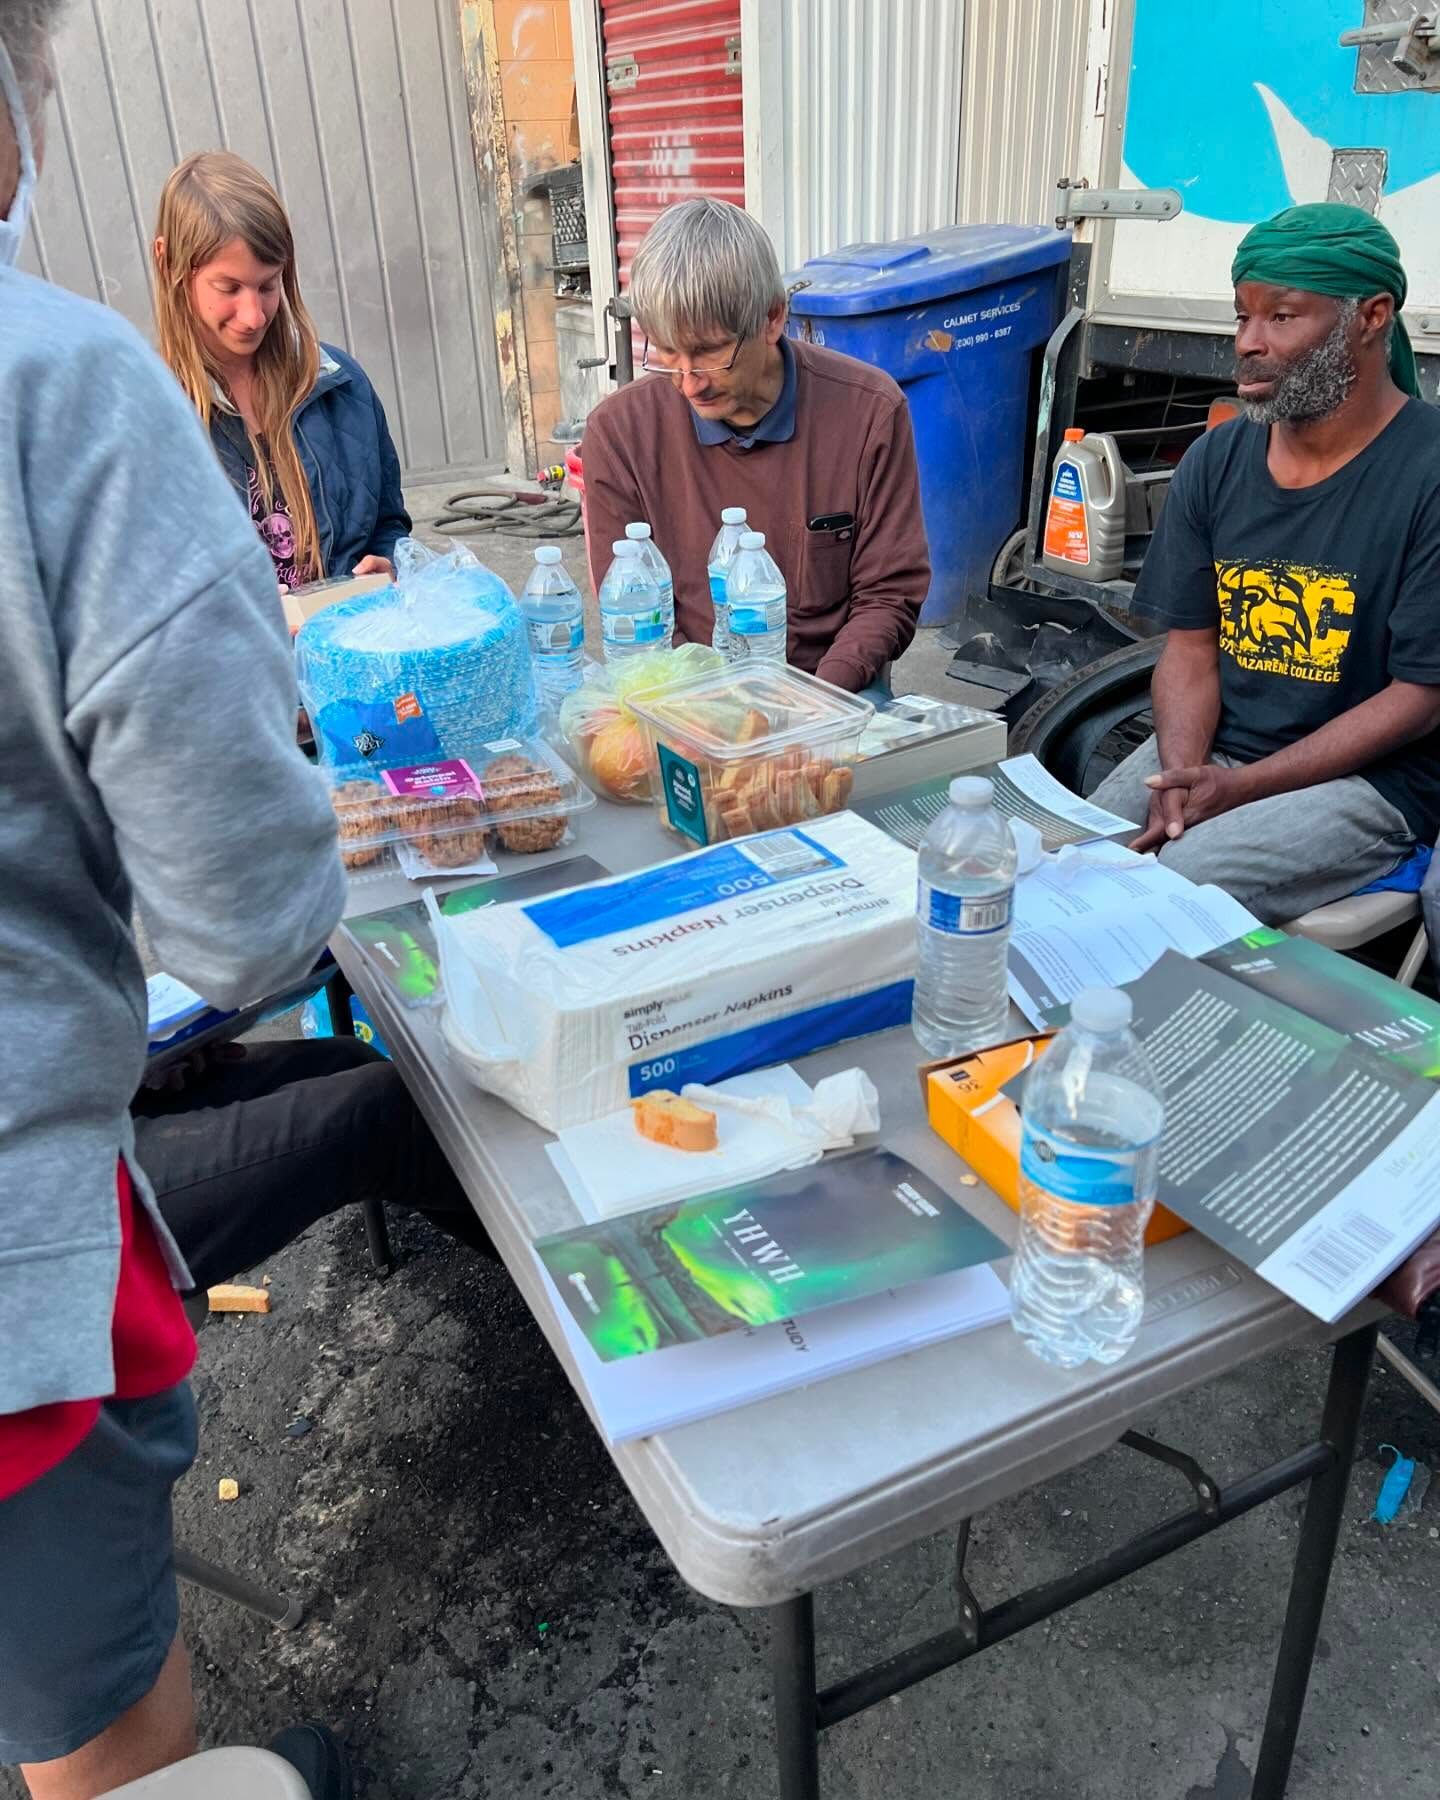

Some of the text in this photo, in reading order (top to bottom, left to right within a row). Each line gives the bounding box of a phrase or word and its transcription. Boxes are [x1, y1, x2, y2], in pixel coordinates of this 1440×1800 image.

[943, 302, 1021, 329] CALMET SERVICES
[1290, 664, 1341, 683] COLLEGE
[716, 871, 771, 897] 500
[734, 877, 865, 920] Dispenser
[612, 913, 729, 957] Napkins
[623, 999, 664, 1019] simply
[723, 983, 793, 1017] Napkins
[1353, 1015, 1434, 1048] HWH
[640, 1057, 676, 1081] 500
[722, 1208, 806, 1284] YHWH
[782, 1318, 809, 1352] TUDY
